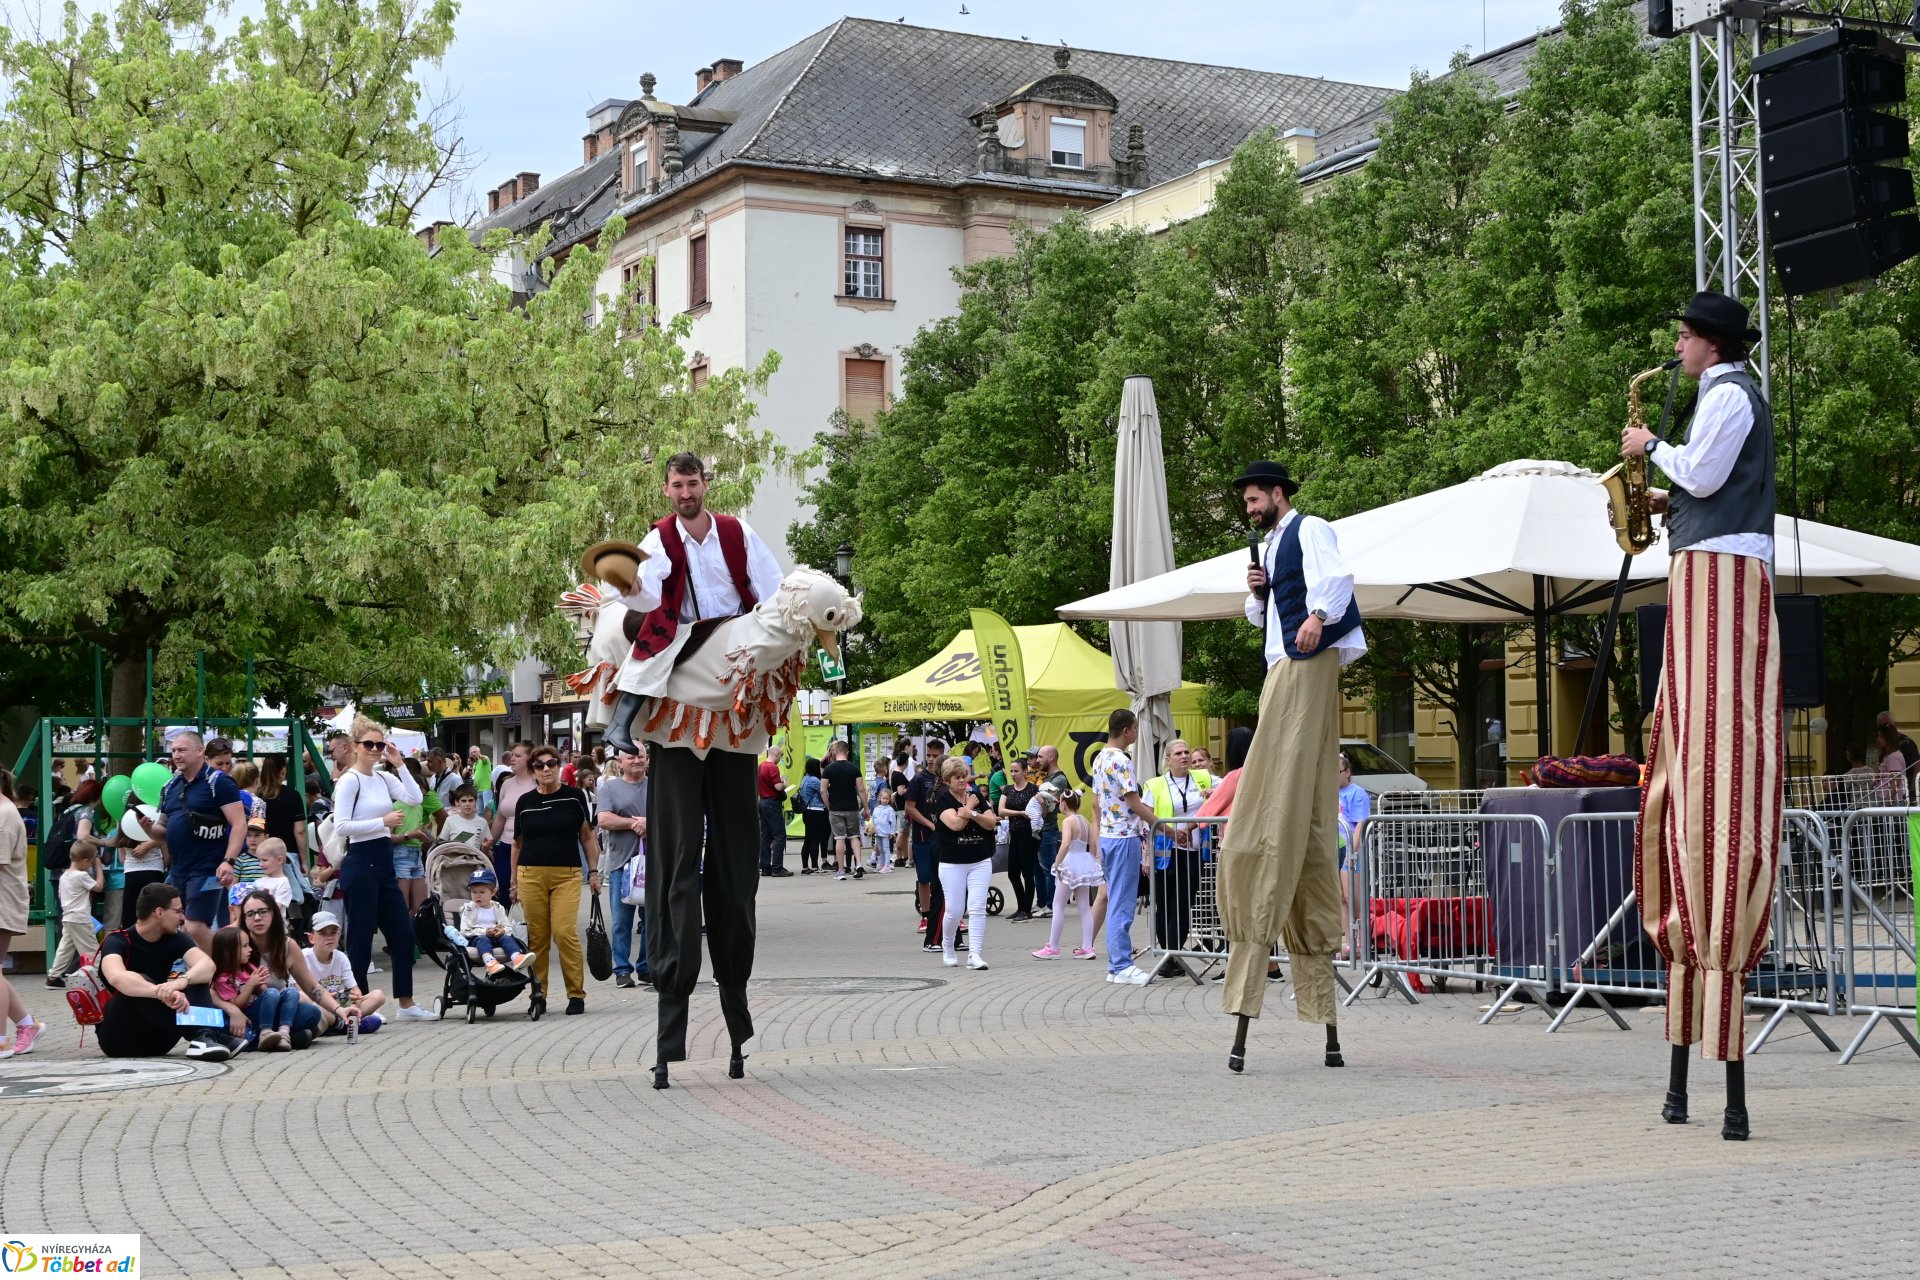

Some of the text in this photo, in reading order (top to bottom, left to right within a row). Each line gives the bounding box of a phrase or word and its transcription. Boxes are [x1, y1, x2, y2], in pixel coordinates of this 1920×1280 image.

[883, 700, 965, 714] Ez életünk nagy dobása.
